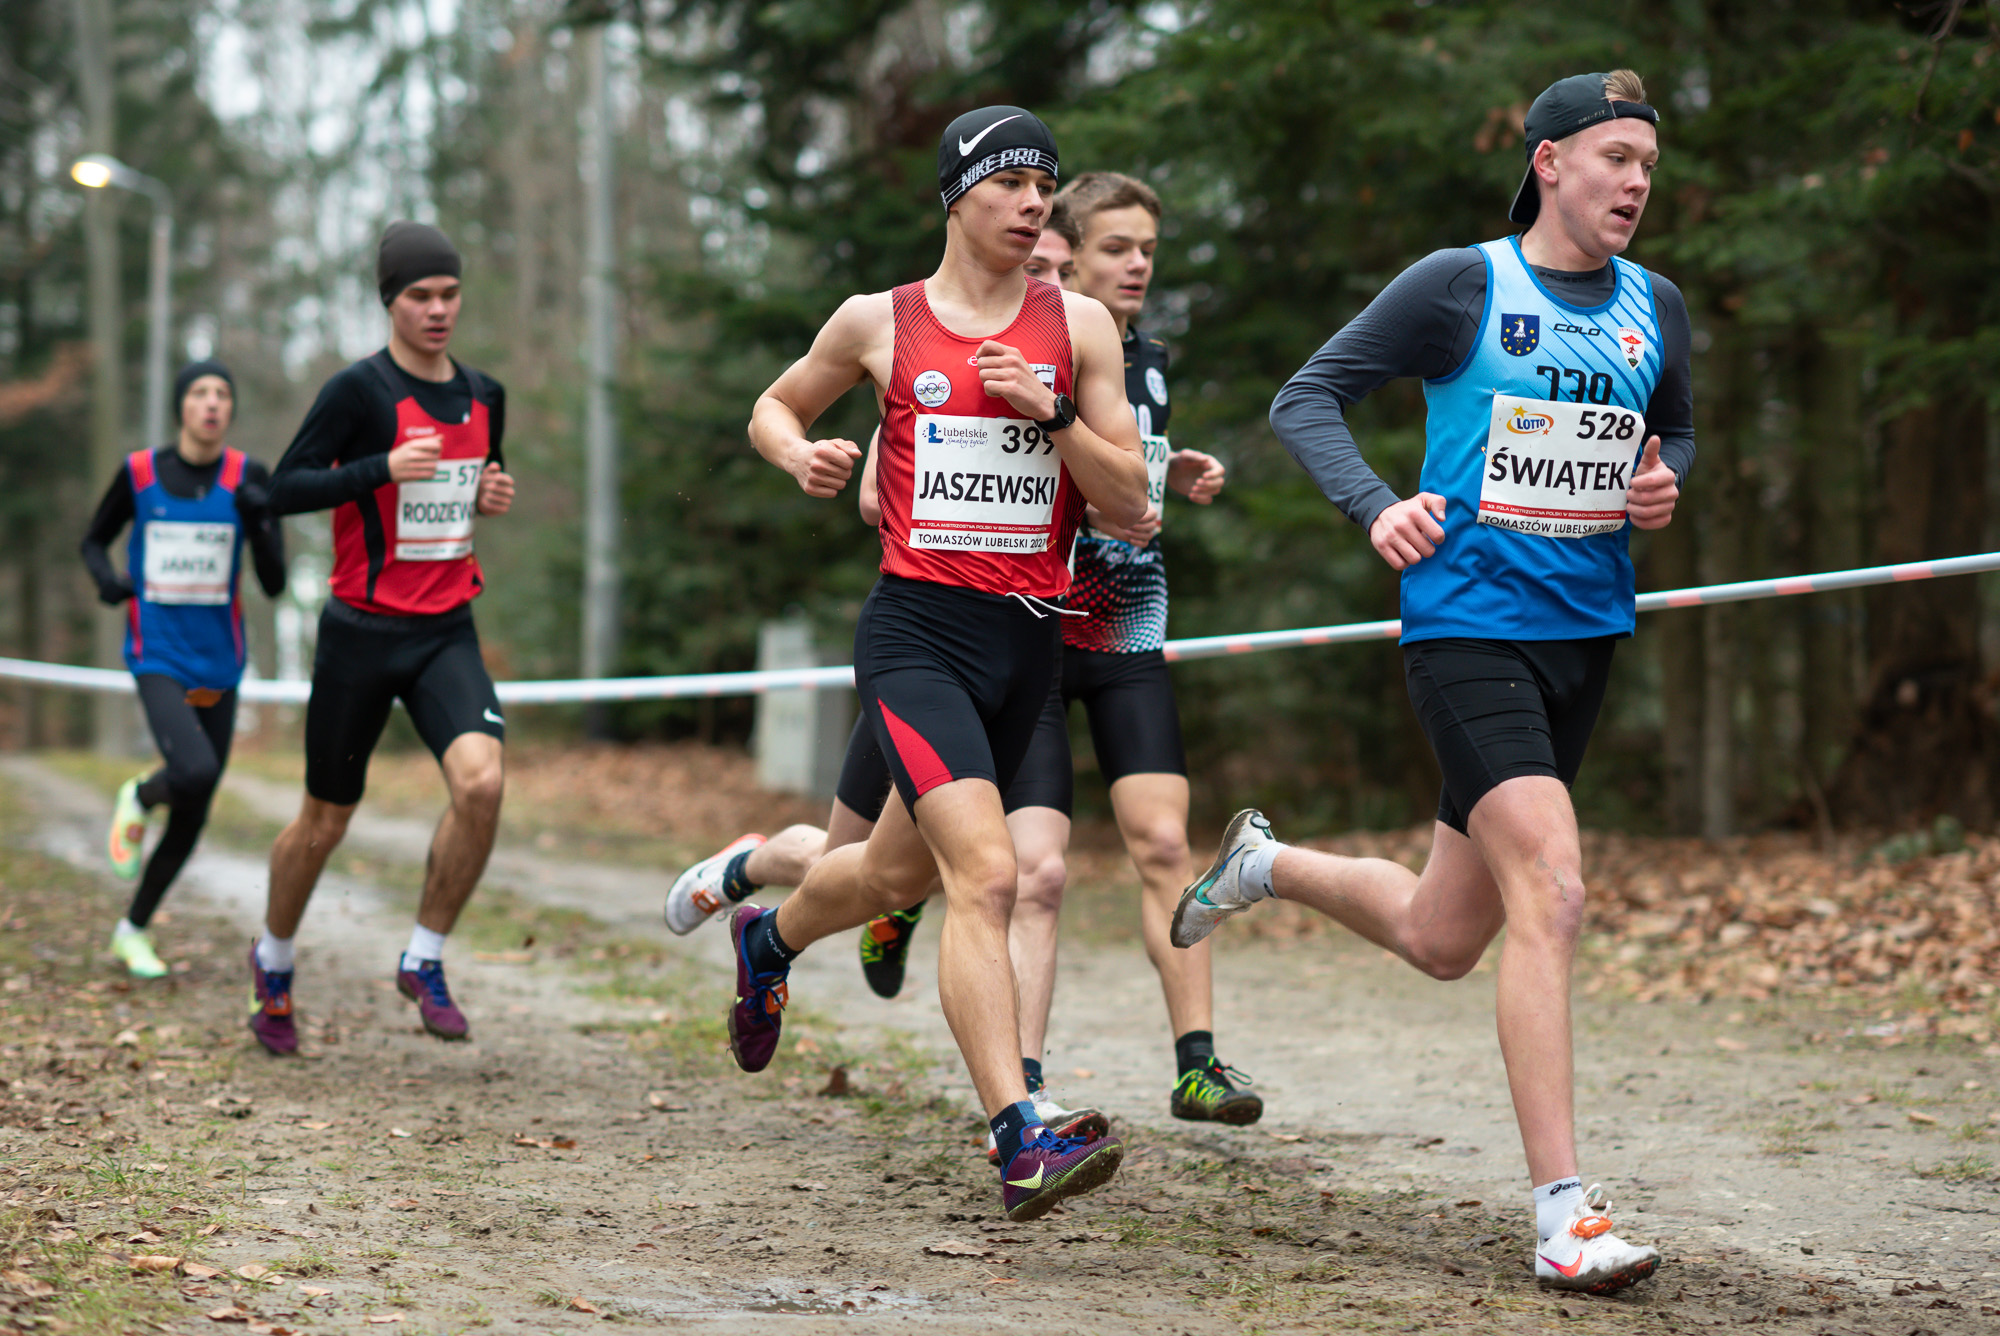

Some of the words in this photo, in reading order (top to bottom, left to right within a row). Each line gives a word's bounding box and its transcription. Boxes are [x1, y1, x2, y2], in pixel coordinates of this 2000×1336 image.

[961, 154, 996, 191] NIKE
[1000, 147, 1040, 168] PRO
[1553, 322, 1601, 337] COLO
[943, 426, 988, 439] lubelskie
[1516, 417, 1546, 430] LOTTO
[1576, 410, 1636, 440] 528
[1488, 446, 1629, 496] ŚWIĄTEK
[918, 470, 1056, 505] JASZEWSKI
[1484, 515, 1552, 532] TOMASZÓW
[1554, 523, 1597, 535] LUBELSKI
[1597, 523, 1618, 533] 2021
[918, 533, 982, 546] TOMASZÓW
[985, 537, 1028, 548] LUBELSKI
